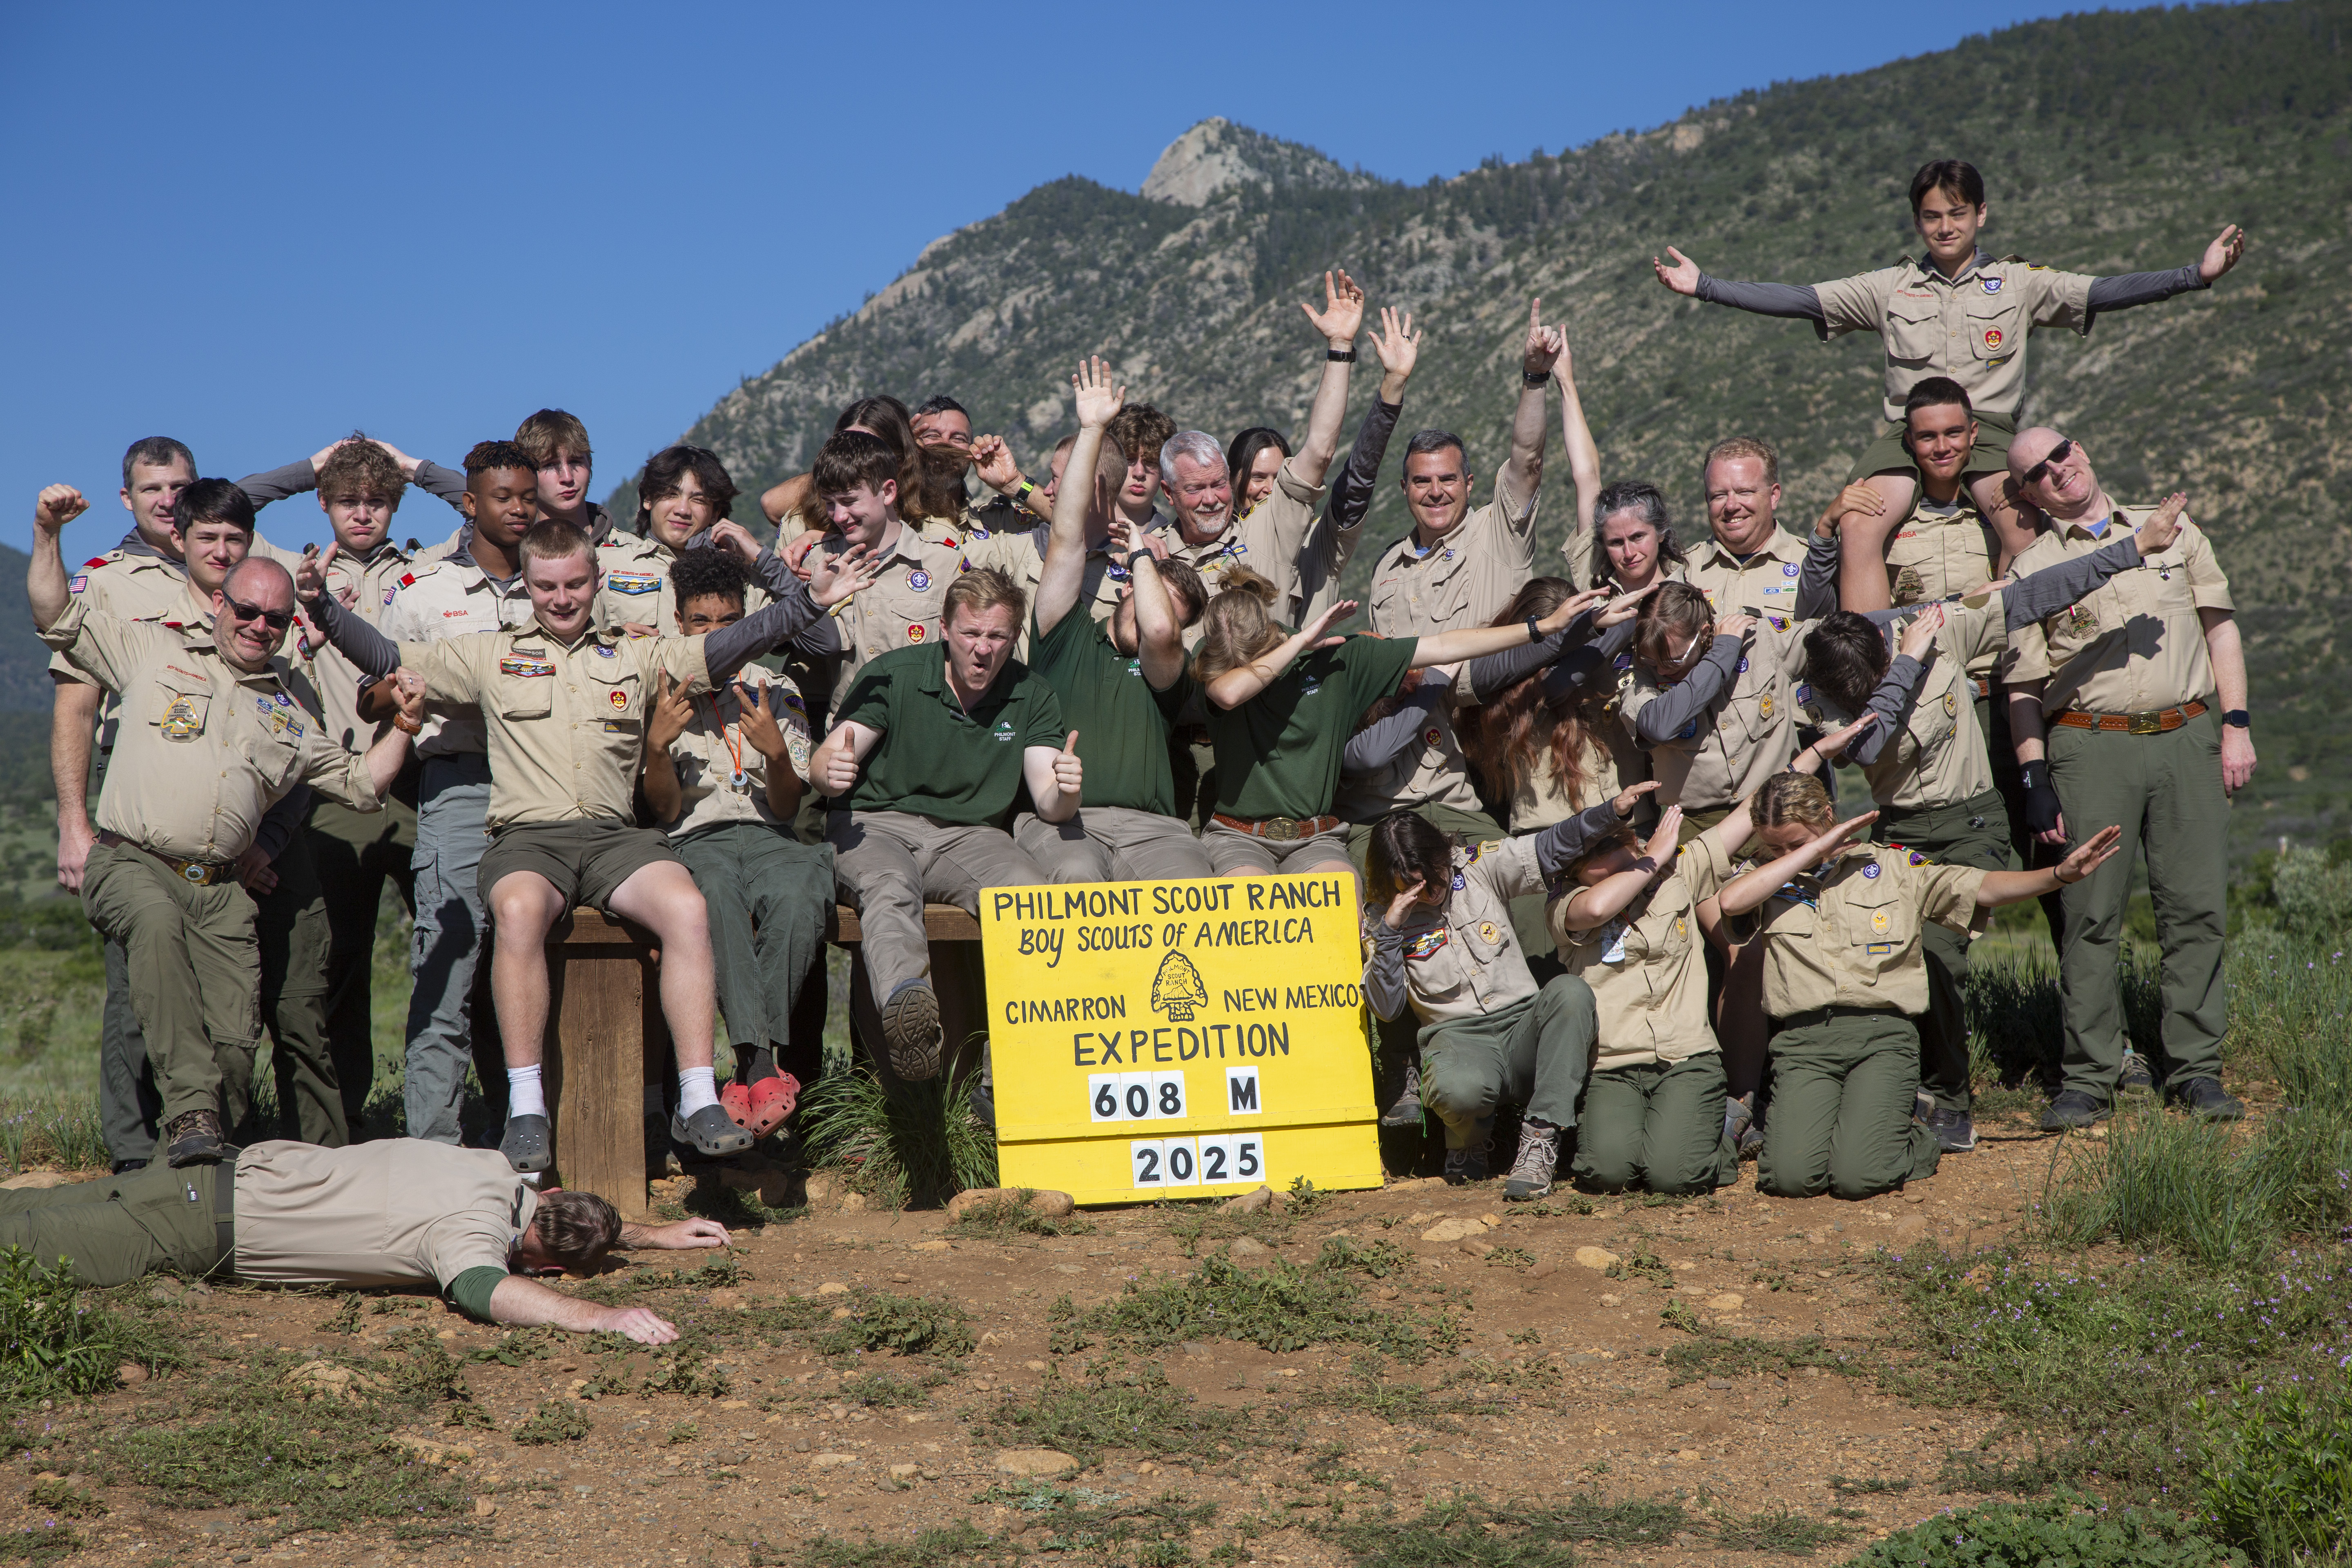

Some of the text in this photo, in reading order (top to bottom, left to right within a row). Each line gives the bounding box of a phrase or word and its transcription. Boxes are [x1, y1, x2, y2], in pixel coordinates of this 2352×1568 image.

[174, 667, 189, 675] SCOUTS
[192, 673, 207, 682] AMERICA
[1301, 683, 1321, 693] PHILMONT
[994, 880, 1341, 921] PHILMONT SCOUT RANCH
[1078, 924, 1152, 952] SCOUTS
[1194, 917, 1314, 947] AMERICA
[1166, 978, 1187, 987] RANCH
[1006, 983, 1359, 1025] CIMARRON NEW MEXICO
[1074, 1022, 1290, 1066] EXPEDITION
[1094, 1077, 1257, 1117] 608 M
[1137, 1143, 1258, 1182] 2025
